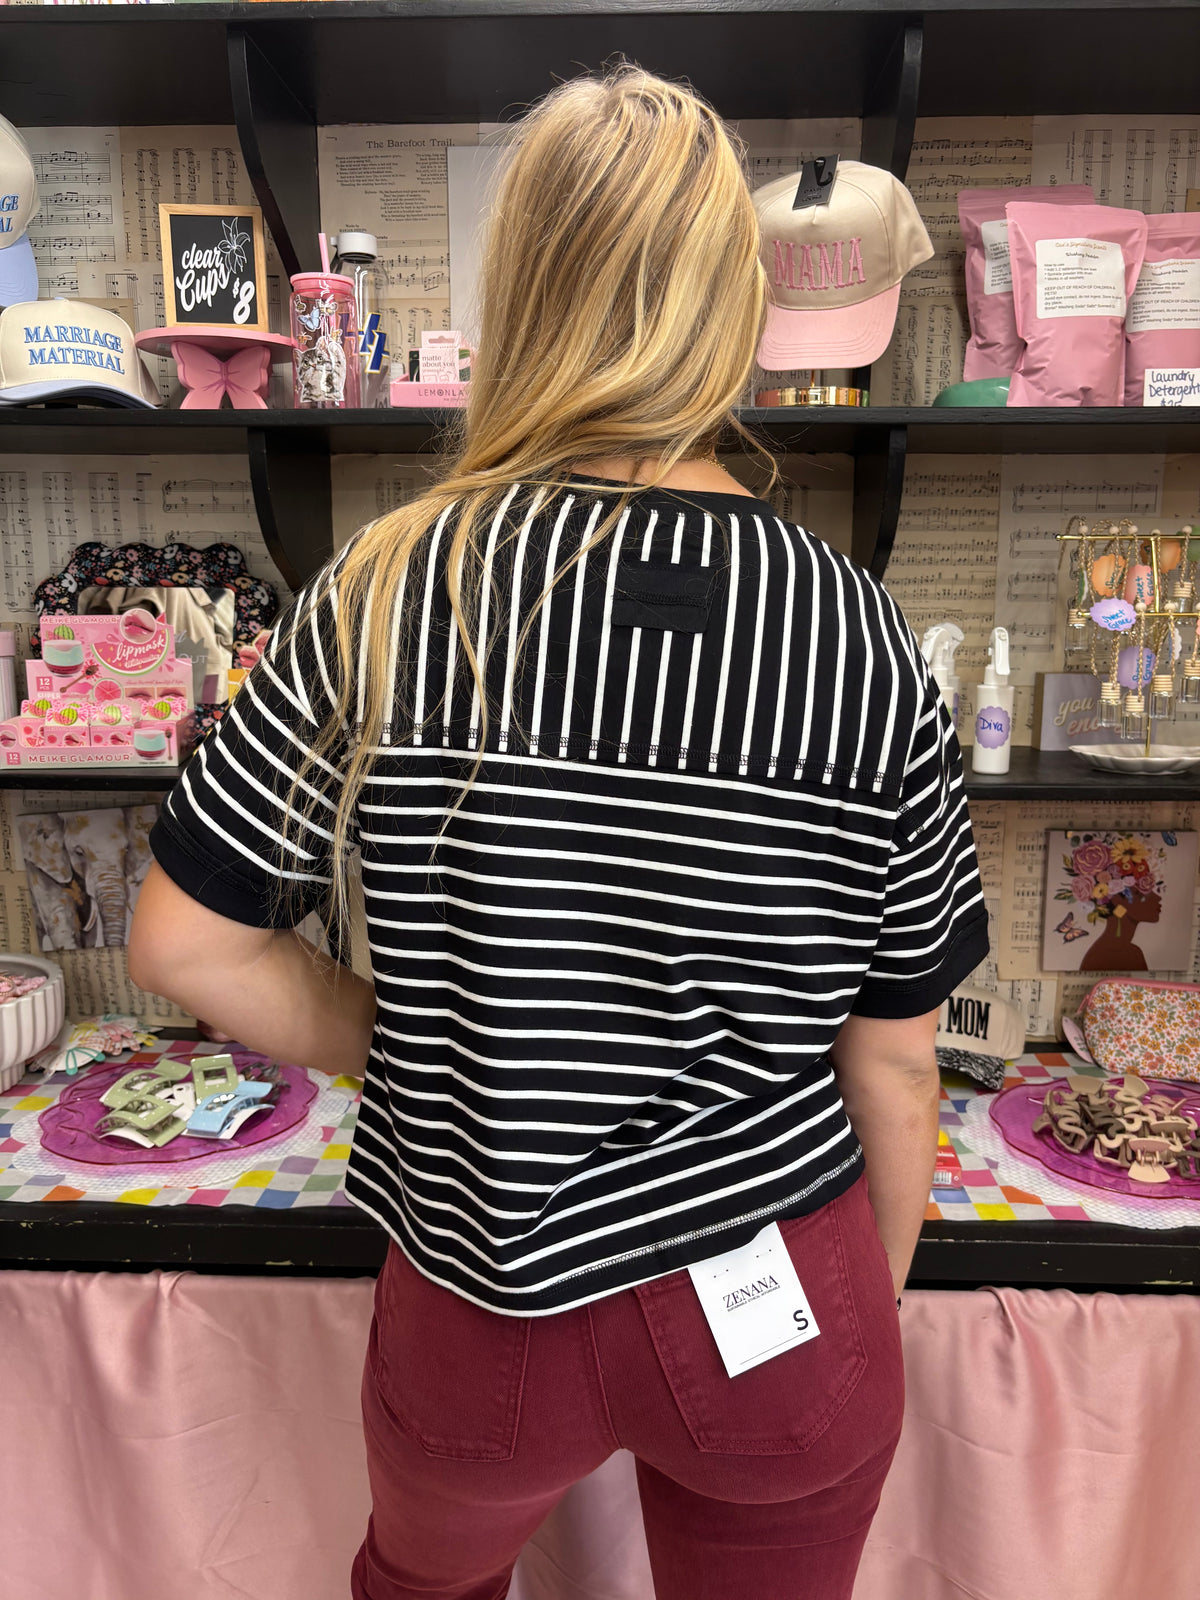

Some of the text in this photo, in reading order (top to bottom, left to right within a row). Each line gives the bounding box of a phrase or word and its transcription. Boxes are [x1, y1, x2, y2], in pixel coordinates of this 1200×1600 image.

[366, 138, 455, 149] The Barefoot Trail.
[181, 242, 224, 270] clear
[772, 238, 866, 291] MAMA
[175, 263, 231, 312] Cups
[23, 325, 123, 353] MARRIAGE
[28, 347, 125, 375] MATERIAL
[1151, 370, 1195, 387] Laundry
[1102, 608, 1126, 624] Sweet
[39, 678, 50, 686] 12
[979, 717, 1004, 733] Diva
[1054, 697, 1095, 726] you
[29, 754, 131, 763] MEIKE GLAMOUR
[945, 996, 991, 1040] MOM
[722, 1275, 778, 1308] ZENANA
[792, 1309, 809, 1331] S
